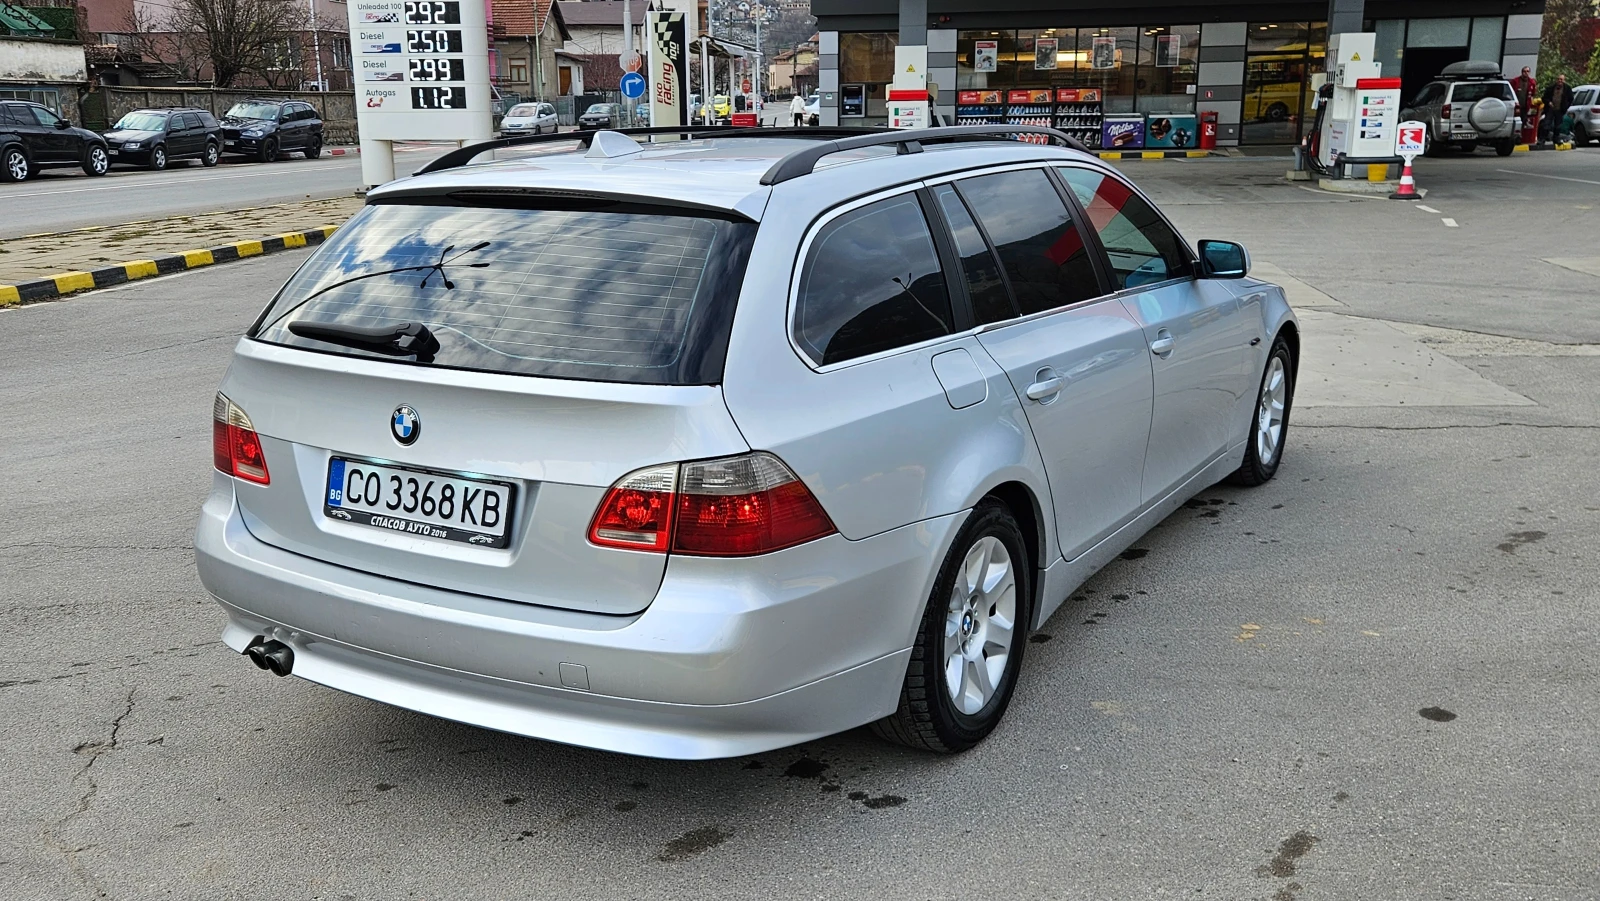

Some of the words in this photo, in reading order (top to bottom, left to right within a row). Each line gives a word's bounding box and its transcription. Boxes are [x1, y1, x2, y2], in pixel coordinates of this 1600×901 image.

[405, 2, 446, 24] 2.92
[360, 32, 384, 40] Diesel
[408, 30, 449, 53] 2.50
[670, 41, 678, 60] 100
[362, 60, 387, 69] Diesel
[409, 59, 451, 81] 2.99
[365, 89, 396, 98] Autogas
[656, 82, 664, 104] EKO
[662, 62, 674, 106] racing
[418, 87, 453, 109] 1.12
[1108, 122, 1135, 137] Milka
[329, 489, 342, 501] BG
[385, 474, 456, 520] 3368
[370, 515, 406, 531] СПАСОВ
[406, 521, 431, 536] АУТО
[430, 528, 448, 539] 2016
